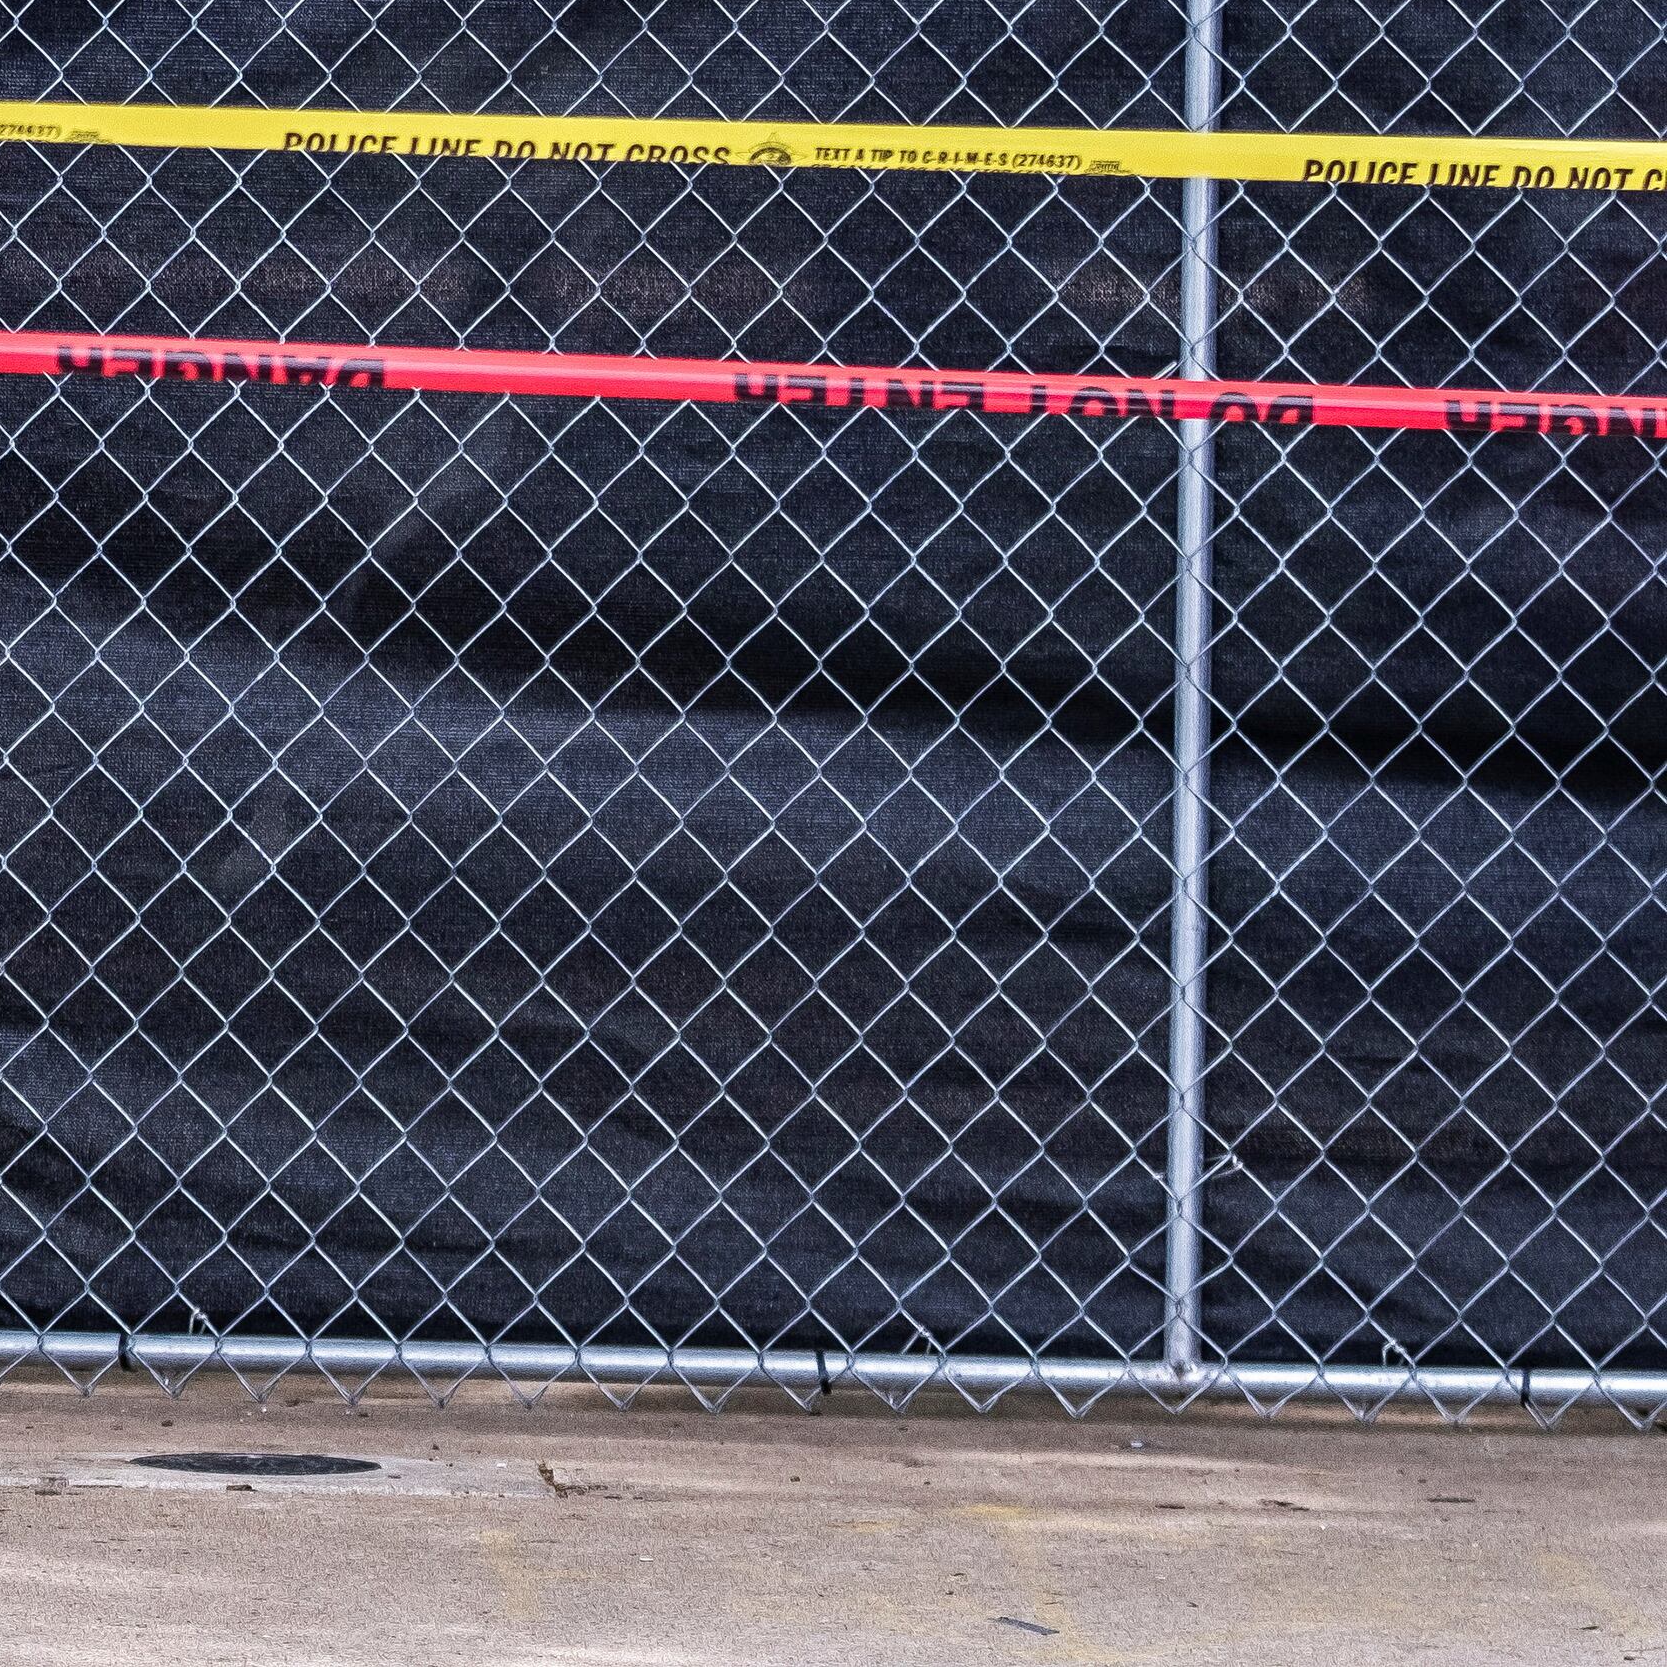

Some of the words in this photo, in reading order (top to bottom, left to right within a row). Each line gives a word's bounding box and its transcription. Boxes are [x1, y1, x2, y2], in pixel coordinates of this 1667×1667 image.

[282, 133, 401, 156] POLICE
[408, 137, 482, 158] LINE
[493, 140, 537, 160] DO
[549, 141, 616, 162] NOT
[624, 144, 733, 165] CROSS
[814, 147, 850, 161] TEXT
[870, 149, 894, 162] TIP
[899, 150, 918, 163] TO
[1011, 154, 1084, 169] (274637)
[1303, 159, 1419, 183] POLICE
[1426, 163, 1498, 187] LINE
[1509, 166, 1555, 188] DO
[1567, 168, 1635, 190] NOT
